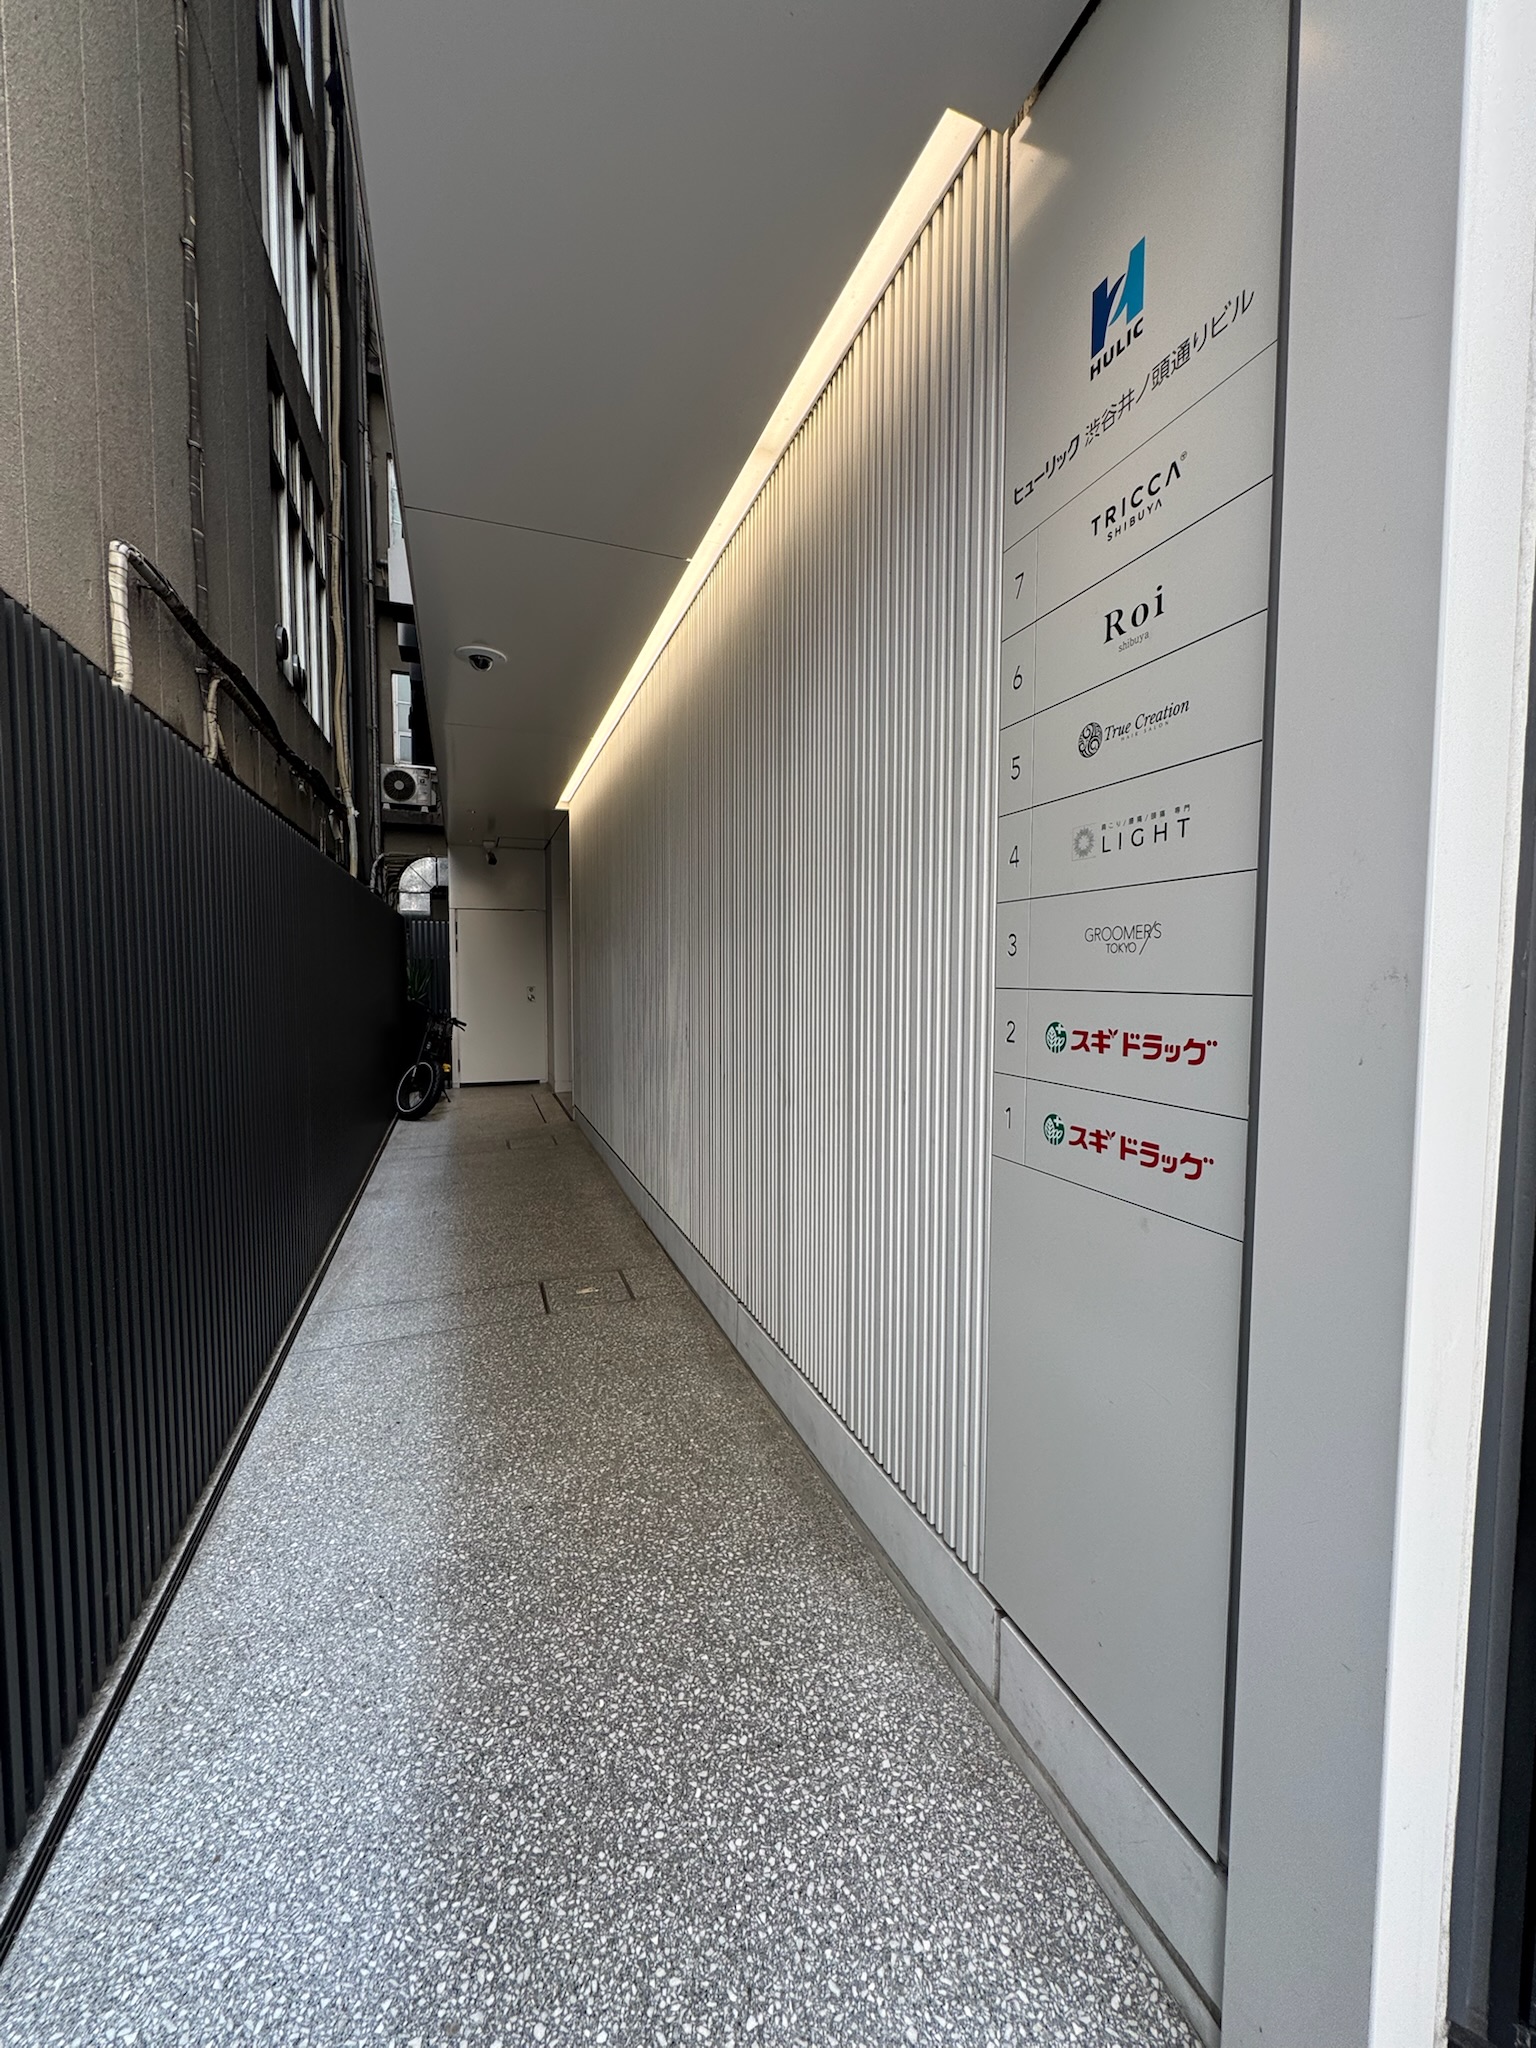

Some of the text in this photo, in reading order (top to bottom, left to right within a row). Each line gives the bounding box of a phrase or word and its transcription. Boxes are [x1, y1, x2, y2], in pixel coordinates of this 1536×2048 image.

[1090, 318, 1144, 382] HULIC
[1013, 289, 1255, 505] ヒューリック 渋谷井ノ頭通りビル
[1091, 461, 1182, 537] TRICCA
[1107, 499, 1162, 542] SHIBUYA
[1014, 572, 1025, 600] 7
[1103, 585, 1165, 645] Roi
[1118, 631, 1150, 653] shibuya
[1012, 665, 1023, 690] 6
[1104, 700, 1190, 742] True Creation
[1010, 755, 1021, 780] 5
[1102, 817, 1190, 853] LIGHT
[1008, 845, 1020, 868] 4
[1007, 933, 1018, 957] 3
[1106, 942, 1137, 954] TOKYO
[1006, 1020, 1016, 1044] 2
[1070, 1028, 1218, 1066] スギドラッグ
[1005, 1107, 1012, 1130] 1
[1068, 1125, 1214, 1181] スギドラッグ
